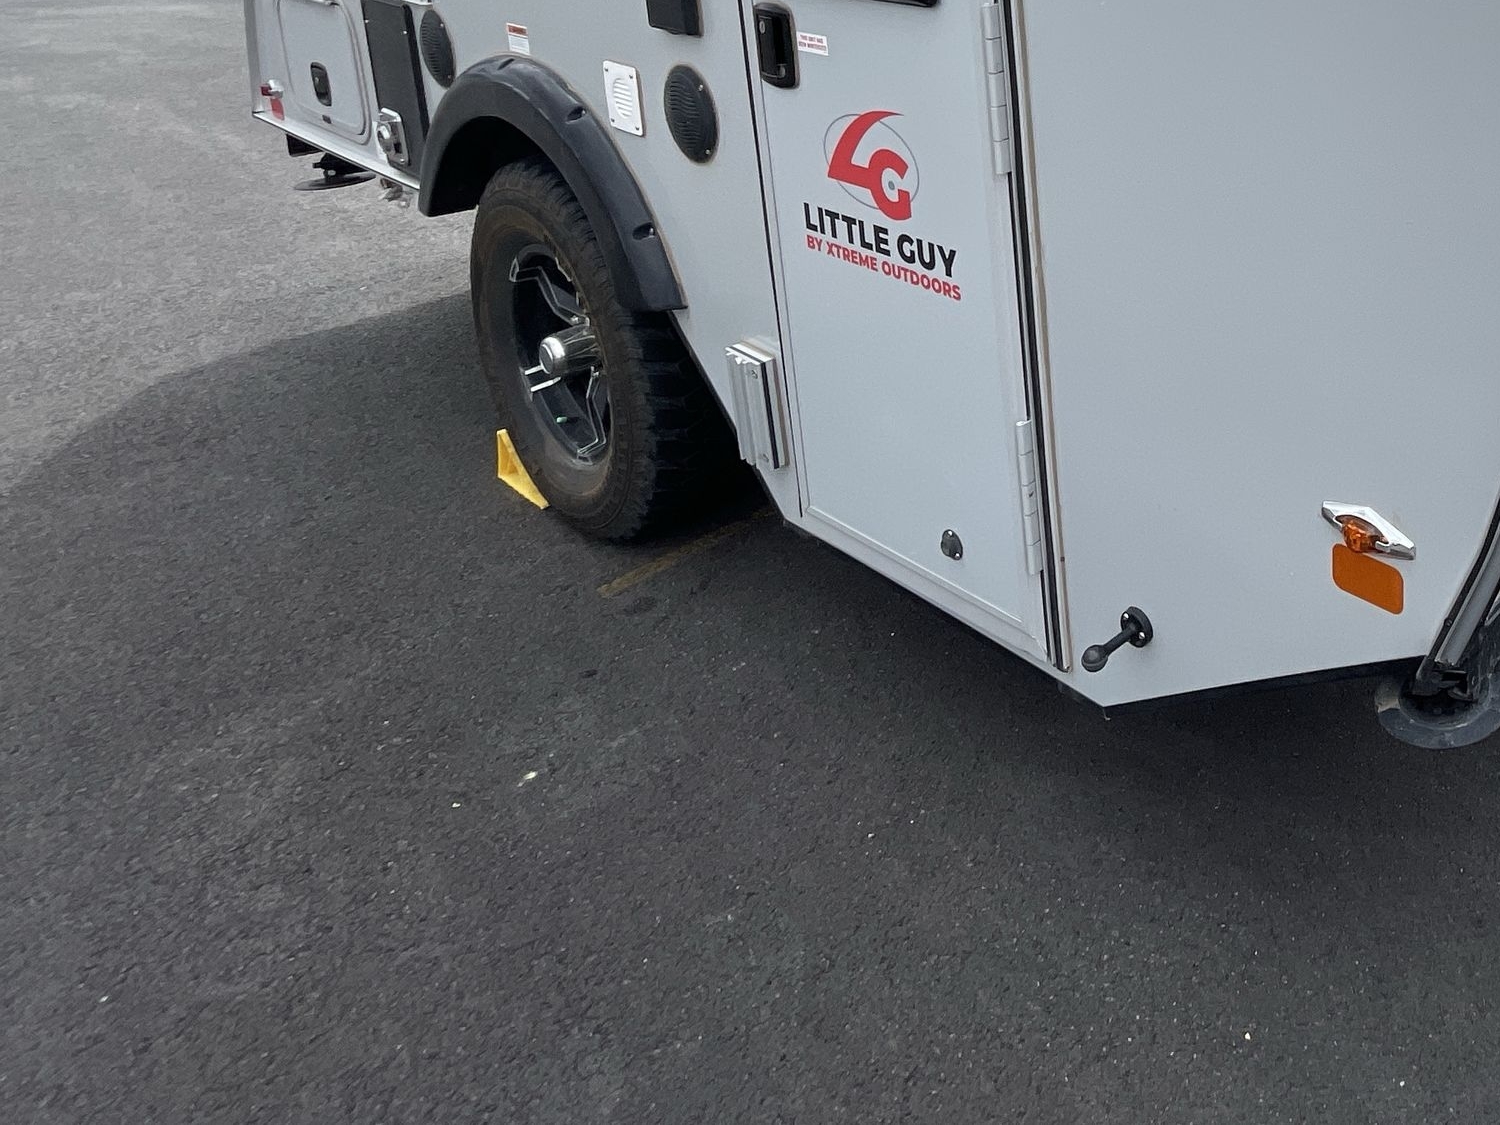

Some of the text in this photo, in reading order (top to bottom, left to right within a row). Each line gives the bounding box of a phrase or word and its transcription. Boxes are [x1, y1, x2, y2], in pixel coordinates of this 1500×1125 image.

[803, 202, 957, 278] LITTLE GUY
[806, 234, 962, 301] BY XTREME OUTDOORS
